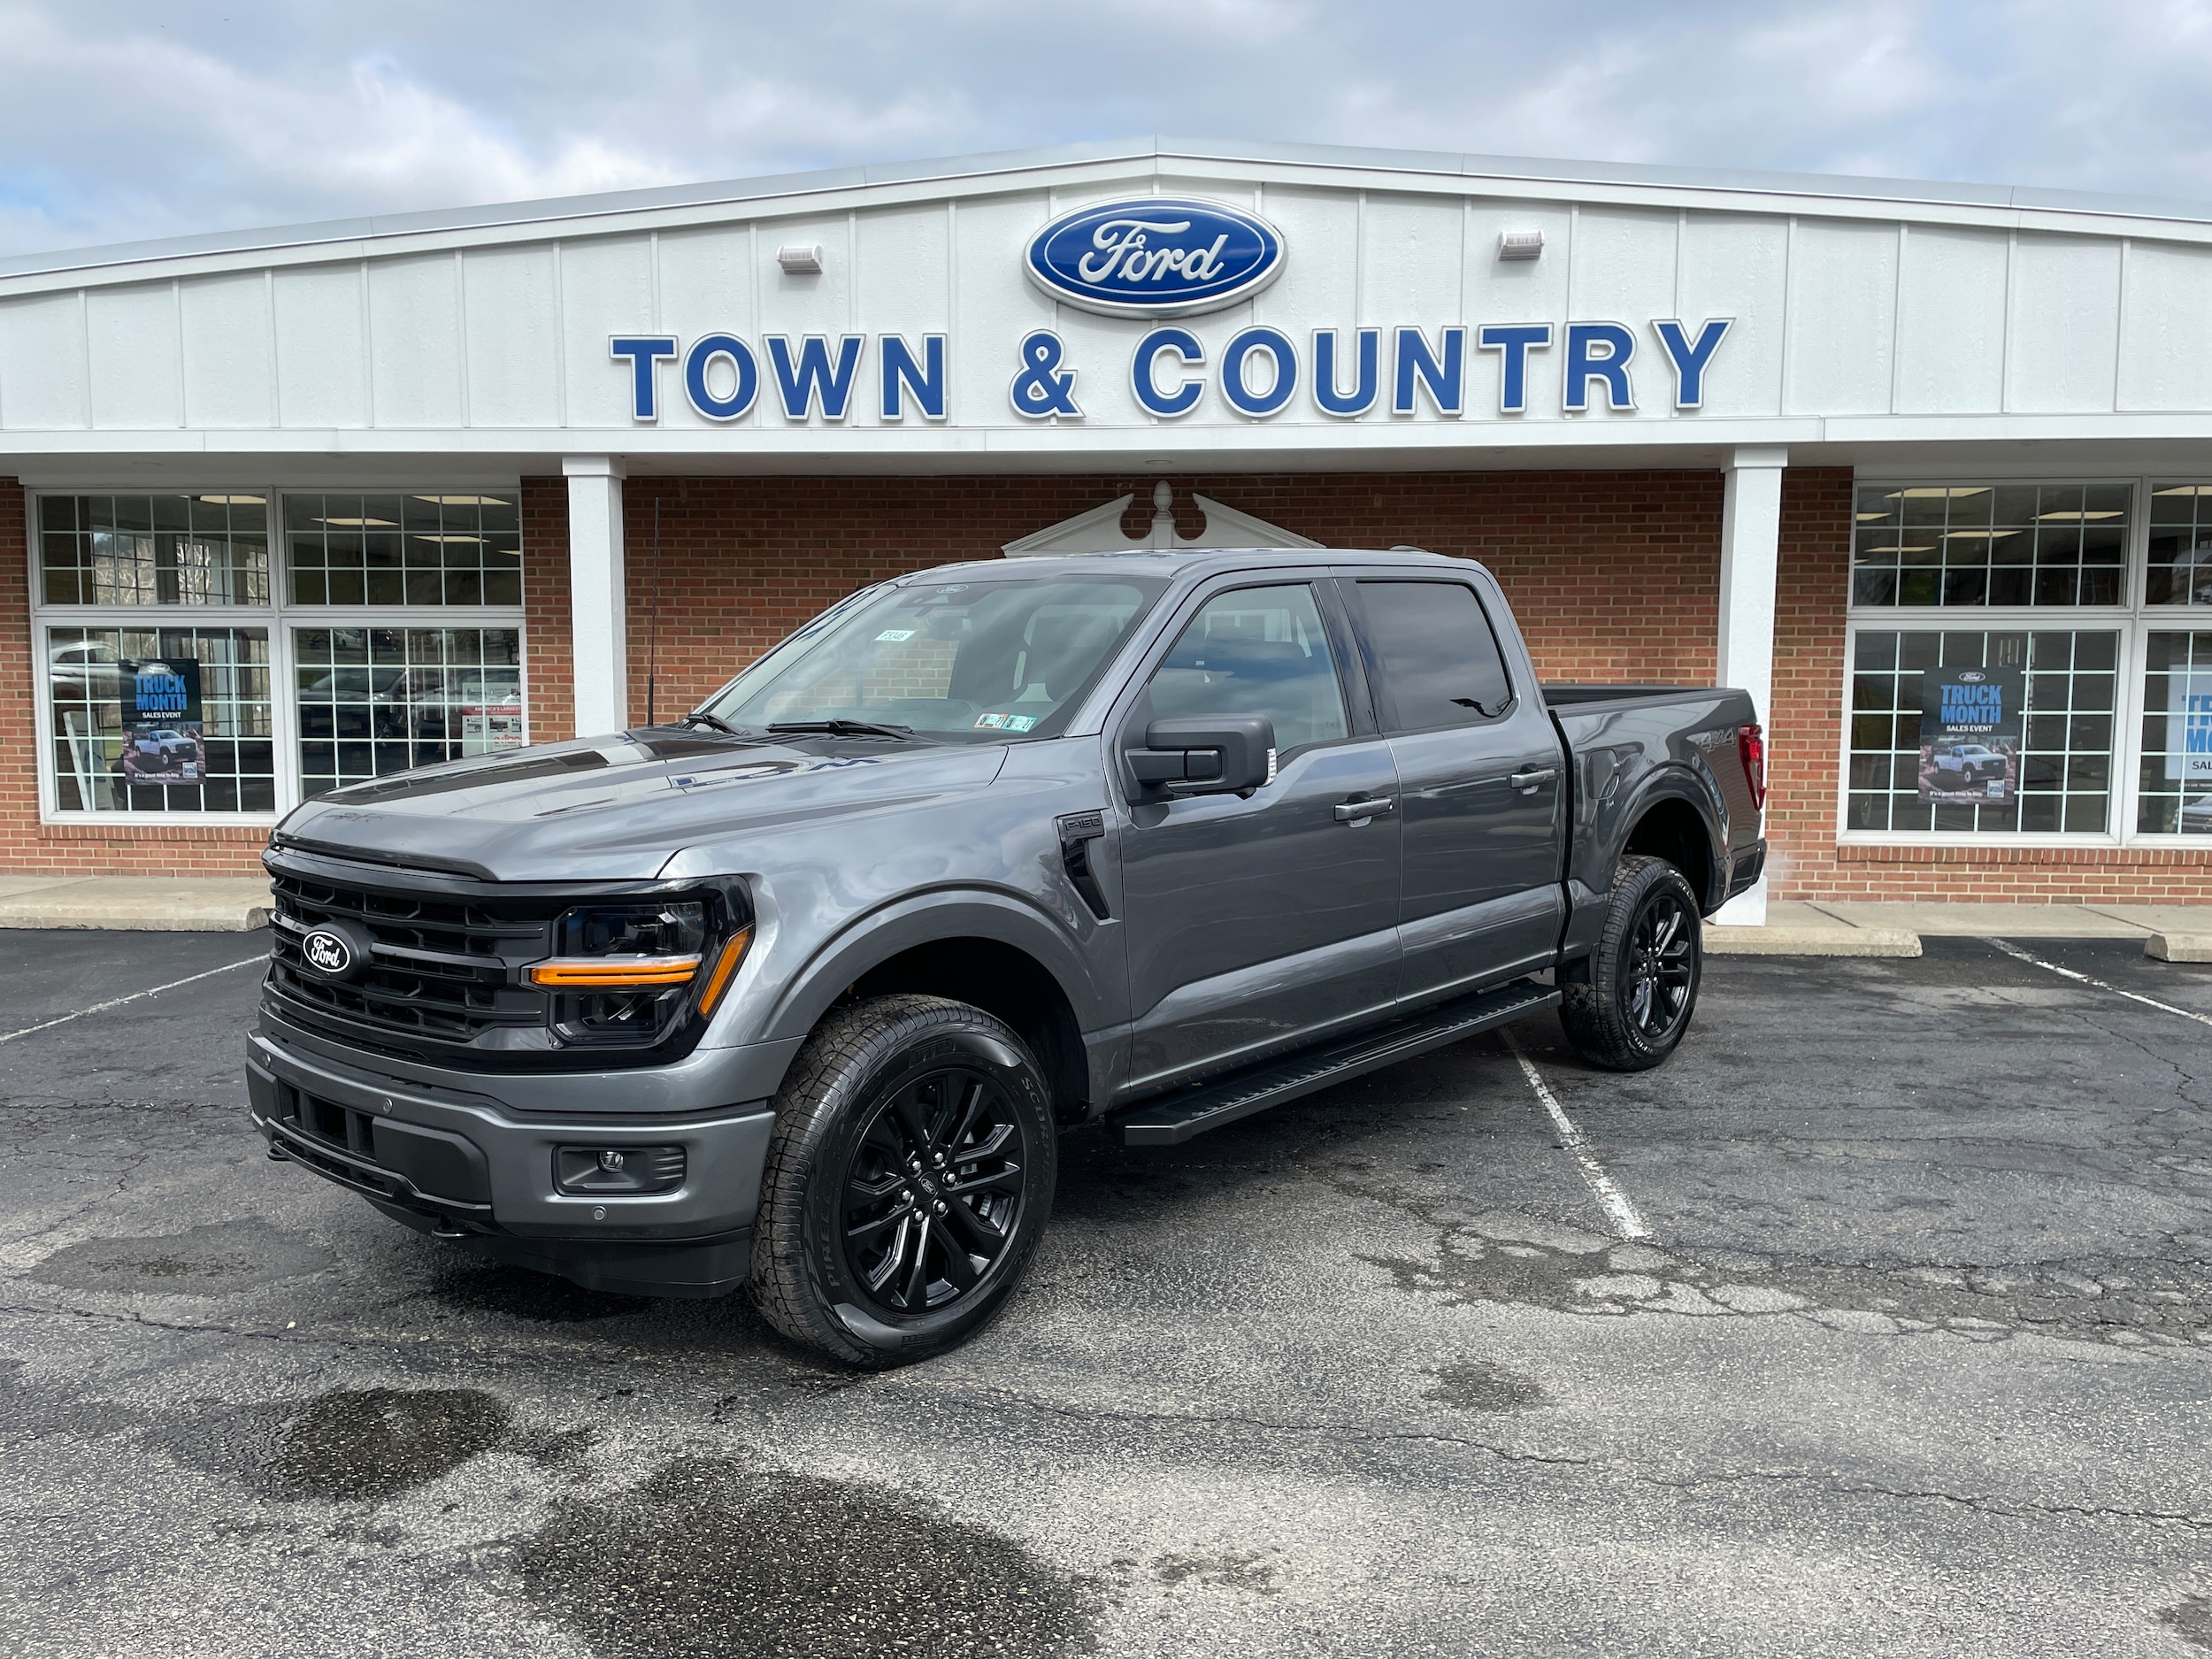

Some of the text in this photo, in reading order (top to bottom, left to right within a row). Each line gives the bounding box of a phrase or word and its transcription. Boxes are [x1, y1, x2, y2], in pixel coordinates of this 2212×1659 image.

[1079, 219, 1229, 283] Ford
[609, 318, 1736, 425] TOWN & COUNTRY
[134, 675, 186, 694] TRUCK
[136, 693, 188, 711] MONTH
[1940, 685, 2002, 705] TRUCK
[1940, 705, 2001, 723] MONTH
[1064, 816, 1101, 831] F-150
[311, 935, 341, 967] Ford
